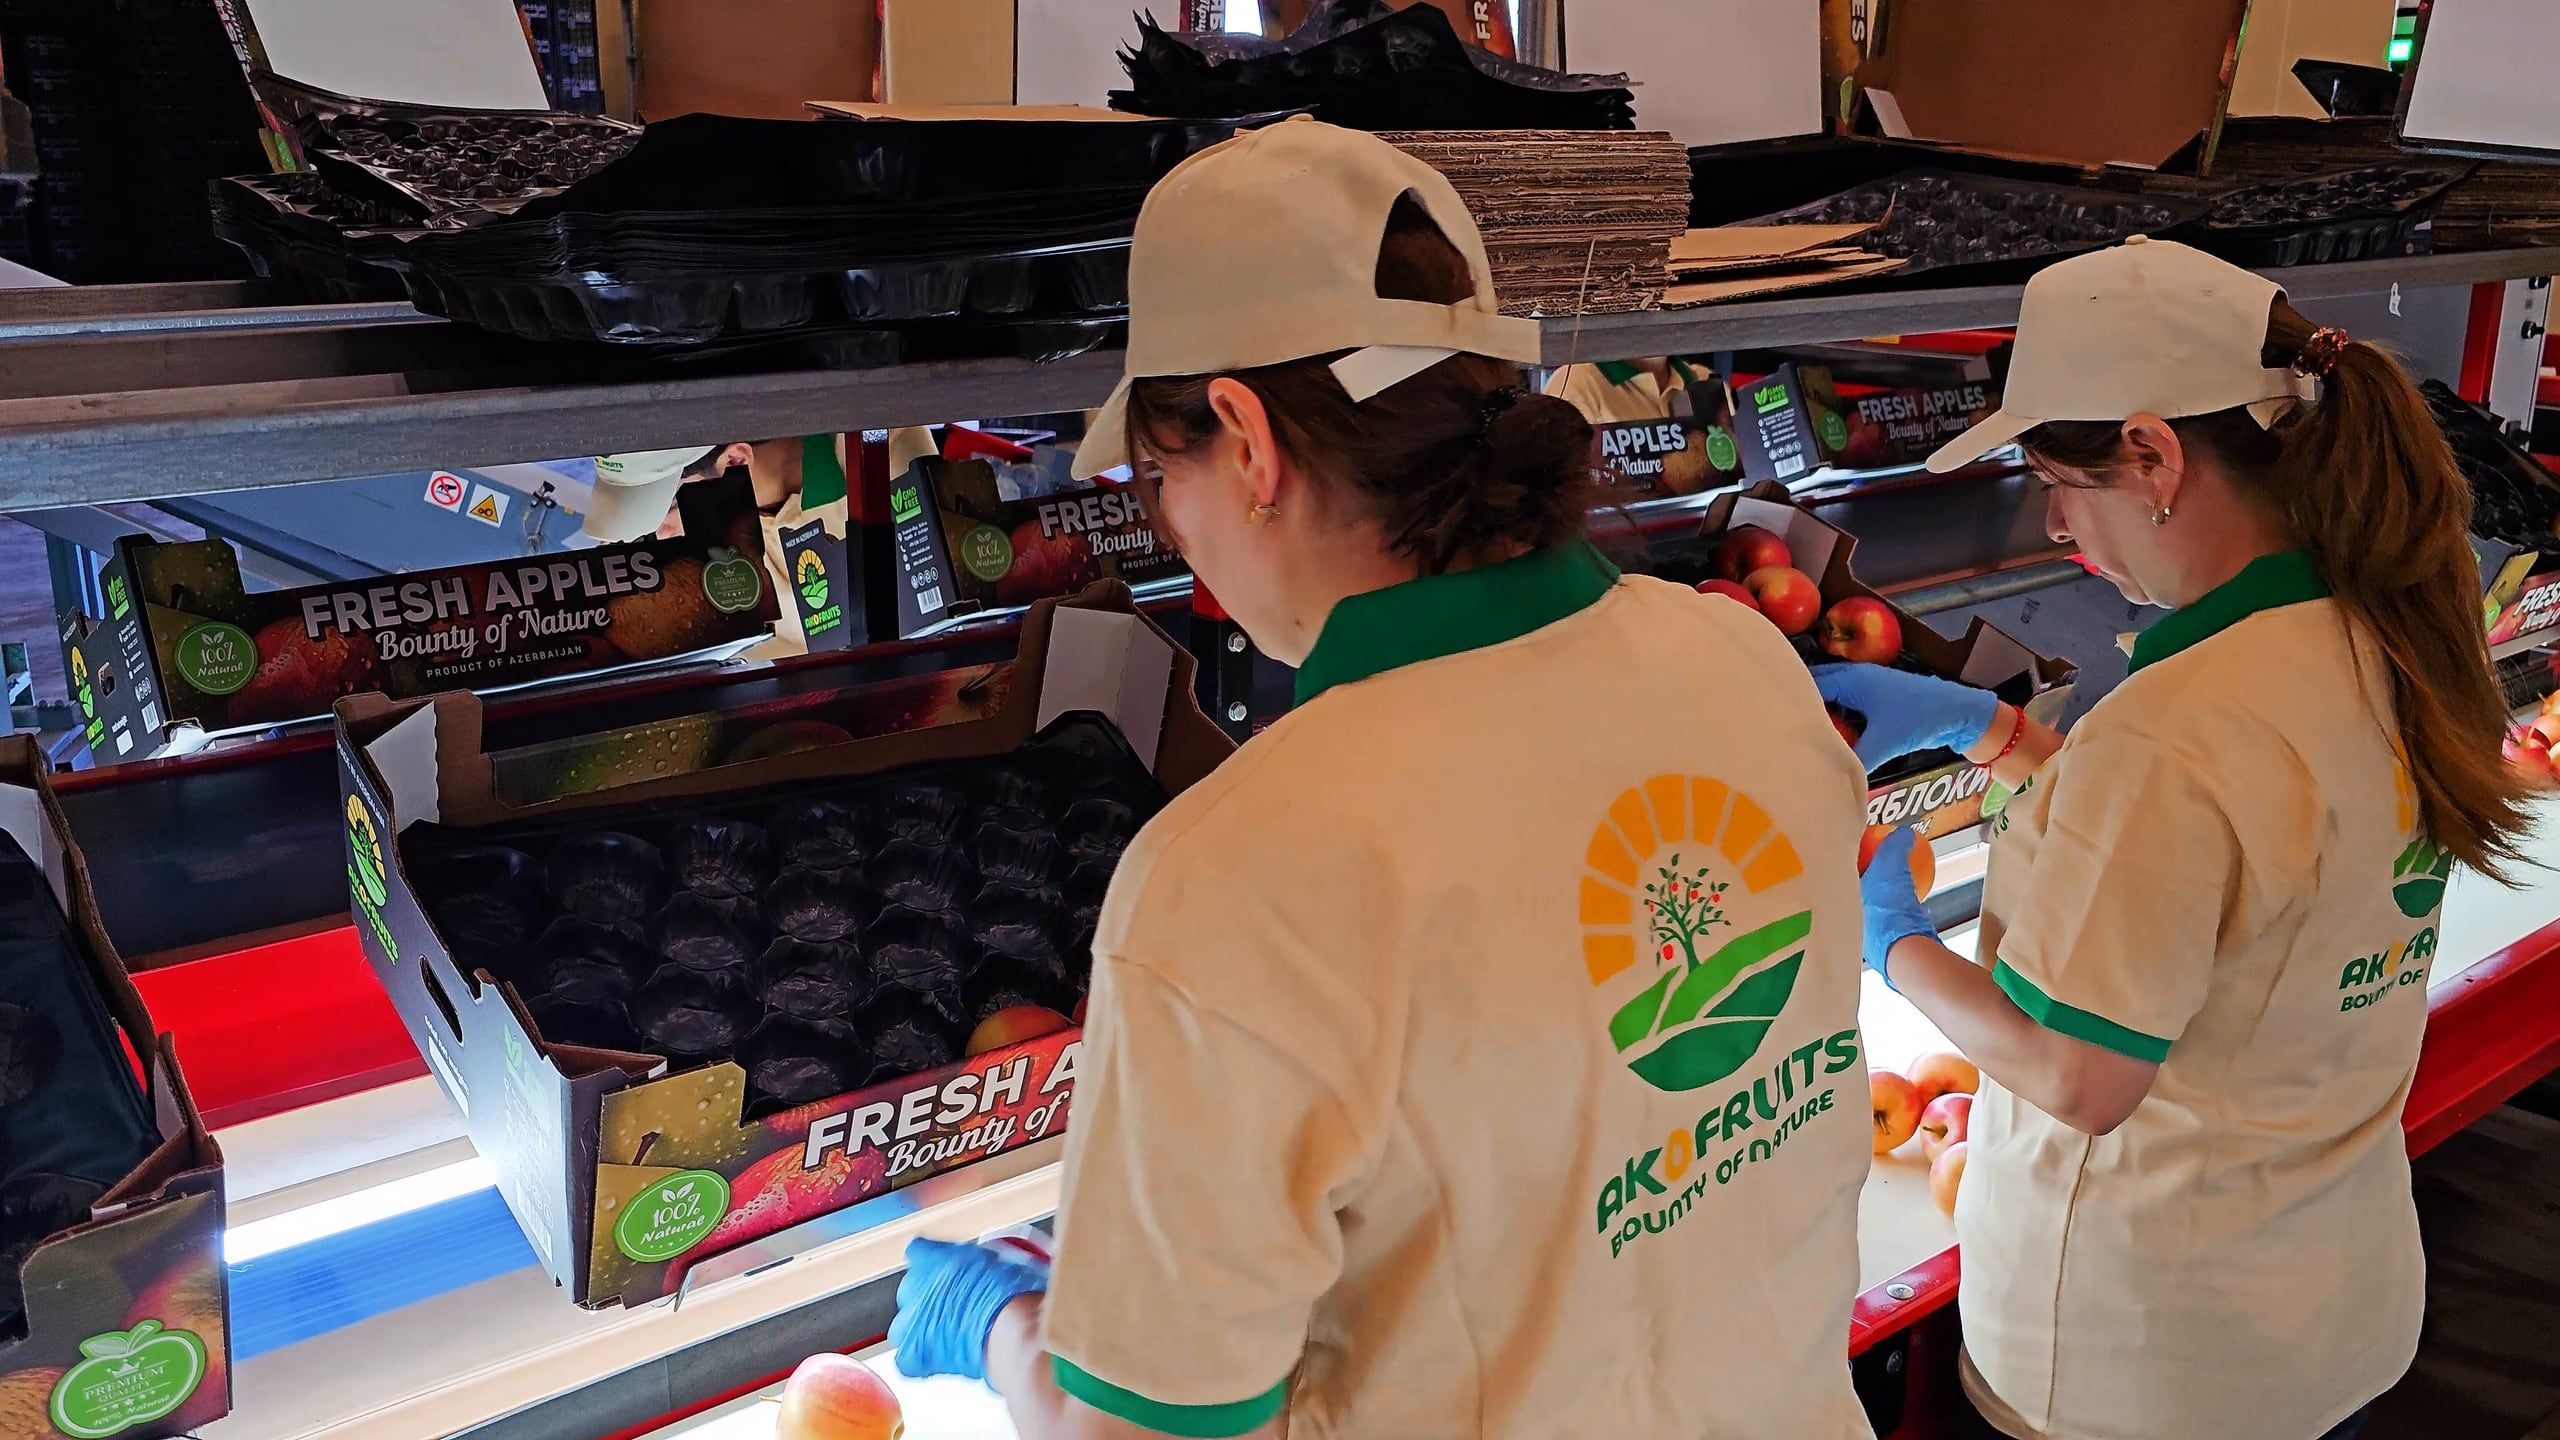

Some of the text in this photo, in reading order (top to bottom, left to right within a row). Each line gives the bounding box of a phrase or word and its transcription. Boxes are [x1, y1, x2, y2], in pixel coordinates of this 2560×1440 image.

[1858, 386, 1987, 424] FRESH APPLES
[1602, 423, 1686, 457] APPLES
[1935, 415, 1969, 432] Nature
[1618, 456, 1664, 476] Nature
[903, 486, 917, 500] GMO
[904, 496, 920, 511] FREE
[1038, 492, 1147, 538] FRESH
[1088, 527, 1156, 556] Bounty
[301, 551, 661, 638] FRESH APPLES
[375, 608, 611, 661] Bounty of Nature
[197, 661, 244, 677] Natural
[201, 642, 237, 665] 100%
[426, 646, 582, 679] PRODUCT OF AZERBAIJAN
[1867, 767, 1991, 826] ЯБЛОКИ
[2339, 924, 2438, 990] AKOFR
[2399, 968, 2424, 986] OF
[804, 1057, 1029, 1168] FRESH
[885, 1090, 1069, 1177] Bounty of
[1597, 1029, 1858, 1234] AKOFRUITS
[1611, 1089, 1834, 1258] BOUNTY OF NATURE
[654, 1193, 701, 1228] 100%
[640, 1215, 706, 1245] Natural
[85, 1366, 165, 1400] PREMIUM
[99, 1381, 150, 1402] QUALITY
[127, 1395, 172, 1414] Natural
